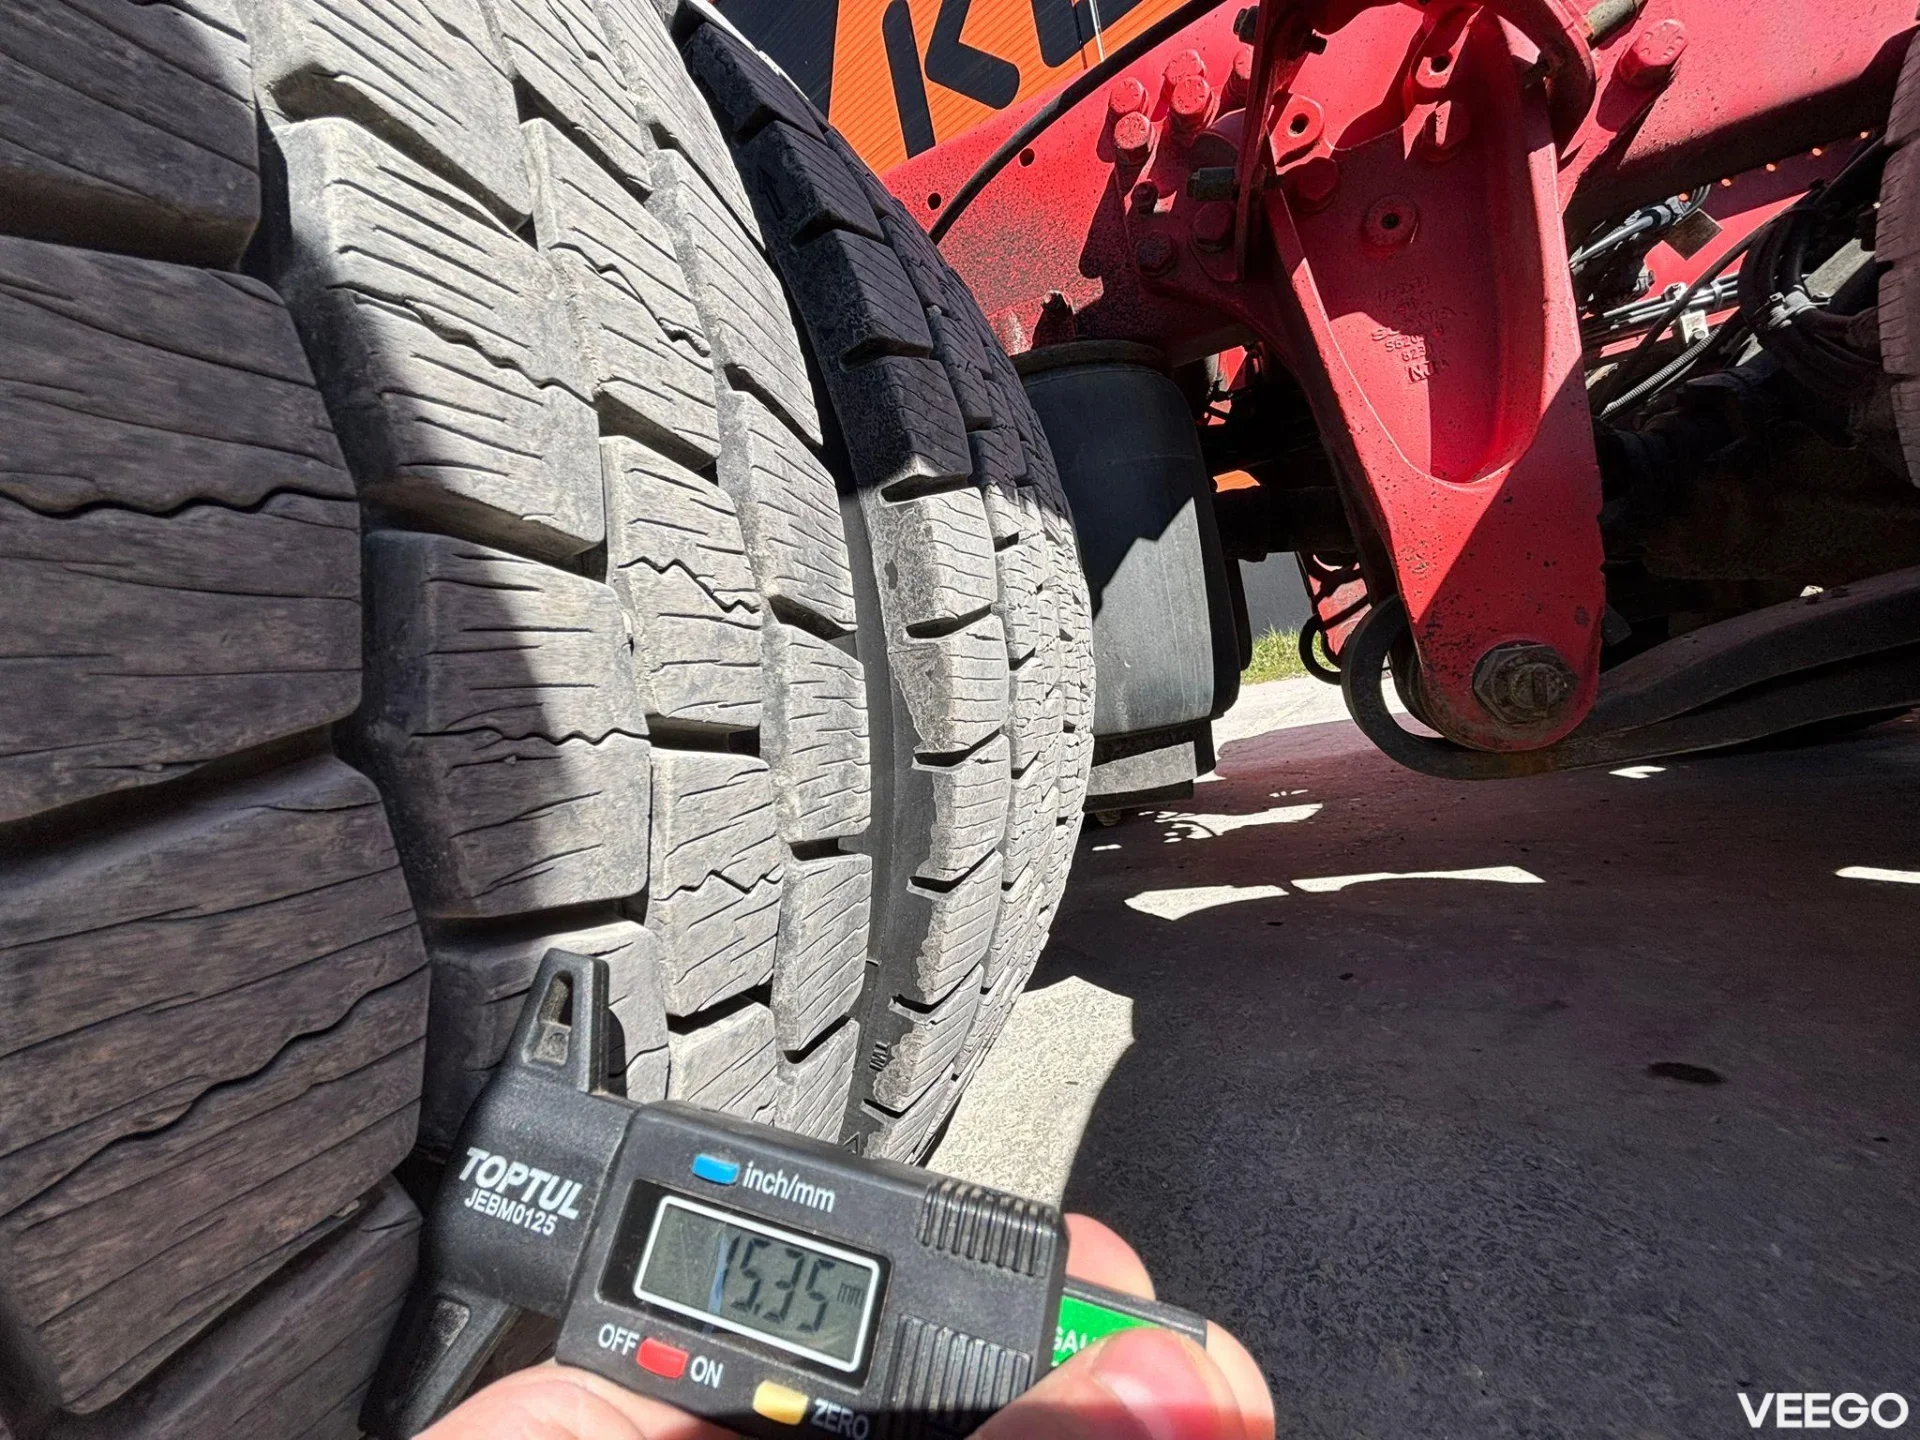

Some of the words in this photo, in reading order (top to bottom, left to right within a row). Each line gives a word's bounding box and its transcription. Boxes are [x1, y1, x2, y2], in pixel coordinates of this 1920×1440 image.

[458, 1147, 583, 1220] TOPTUL
[742, 1160, 836, 1213] inch/mm
[464, 1188, 558, 1236] JEBM0125
[722, 1235, 836, 1333] 15.35
[836, 1282, 867, 1310] mm
[598, 1323, 640, 1355] OFF
[690, 1355, 724, 1389] ON
[811, 1397, 869, 1440] ZERO
